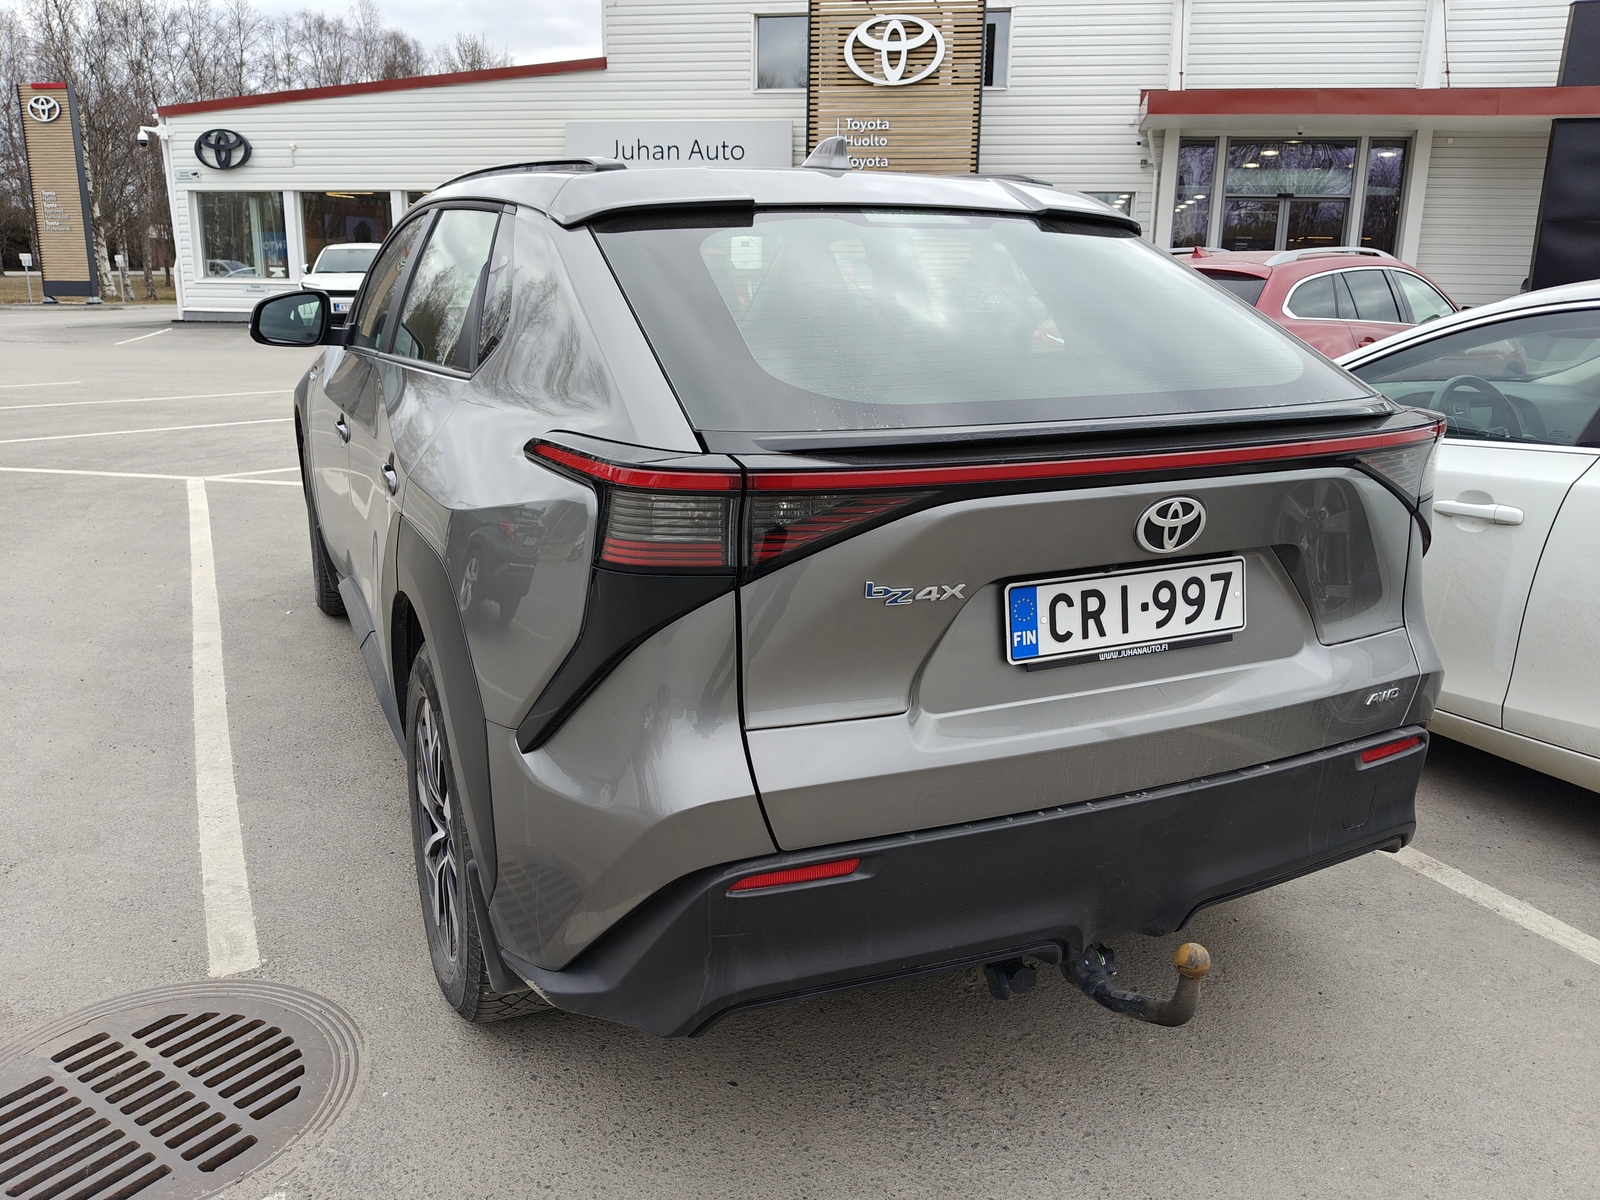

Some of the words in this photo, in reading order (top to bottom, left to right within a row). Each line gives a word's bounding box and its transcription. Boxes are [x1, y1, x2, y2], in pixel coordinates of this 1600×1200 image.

[845, 118, 890, 133] Toyota
[844, 134, 888, 146] Huolto
[613, 138, 680, 161] Juhan
[688, 139, 745, 161] Auto
[1048, 571, 1233, 643] CRI-997
[1013, 629, 1037, 647] FIN
[1098, 643, 1169, 661] WWW.JUHANAUTO.FI
